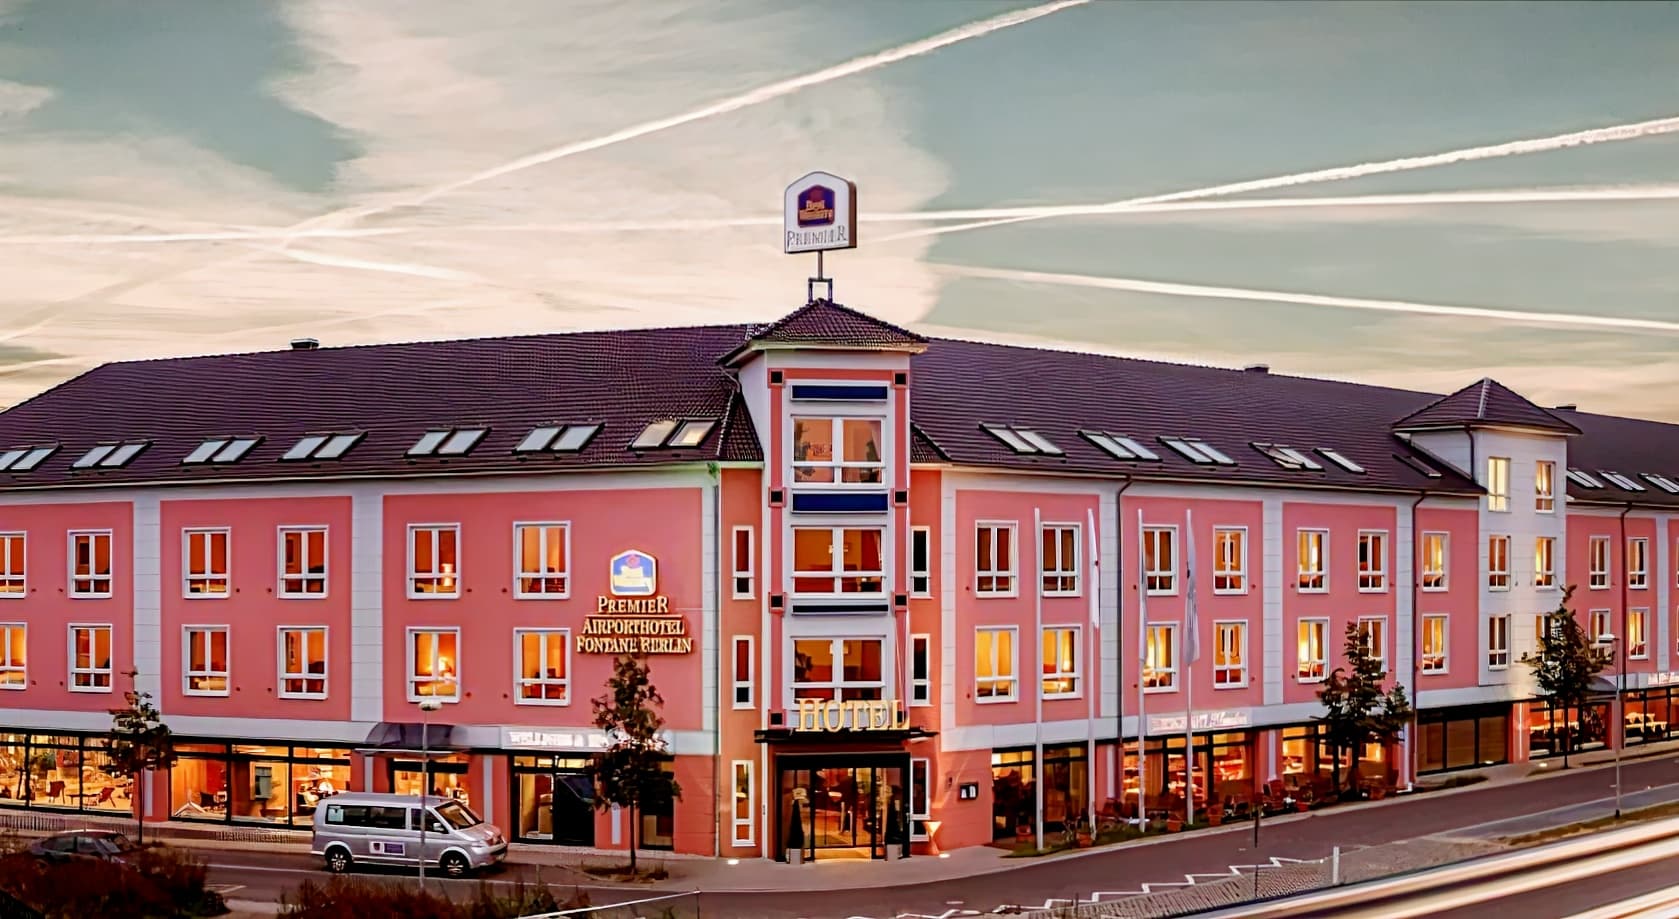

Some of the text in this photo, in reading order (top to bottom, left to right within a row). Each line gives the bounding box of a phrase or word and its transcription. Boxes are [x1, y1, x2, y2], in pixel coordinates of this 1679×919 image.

[597, 595, 669, 613] PREMIER
[582, 618, 685, 635] AIRPORTHOTEL
[576, 636, 692, 653] FONTANE BERLIN
[795, 697, 910, 732] HOTEL
